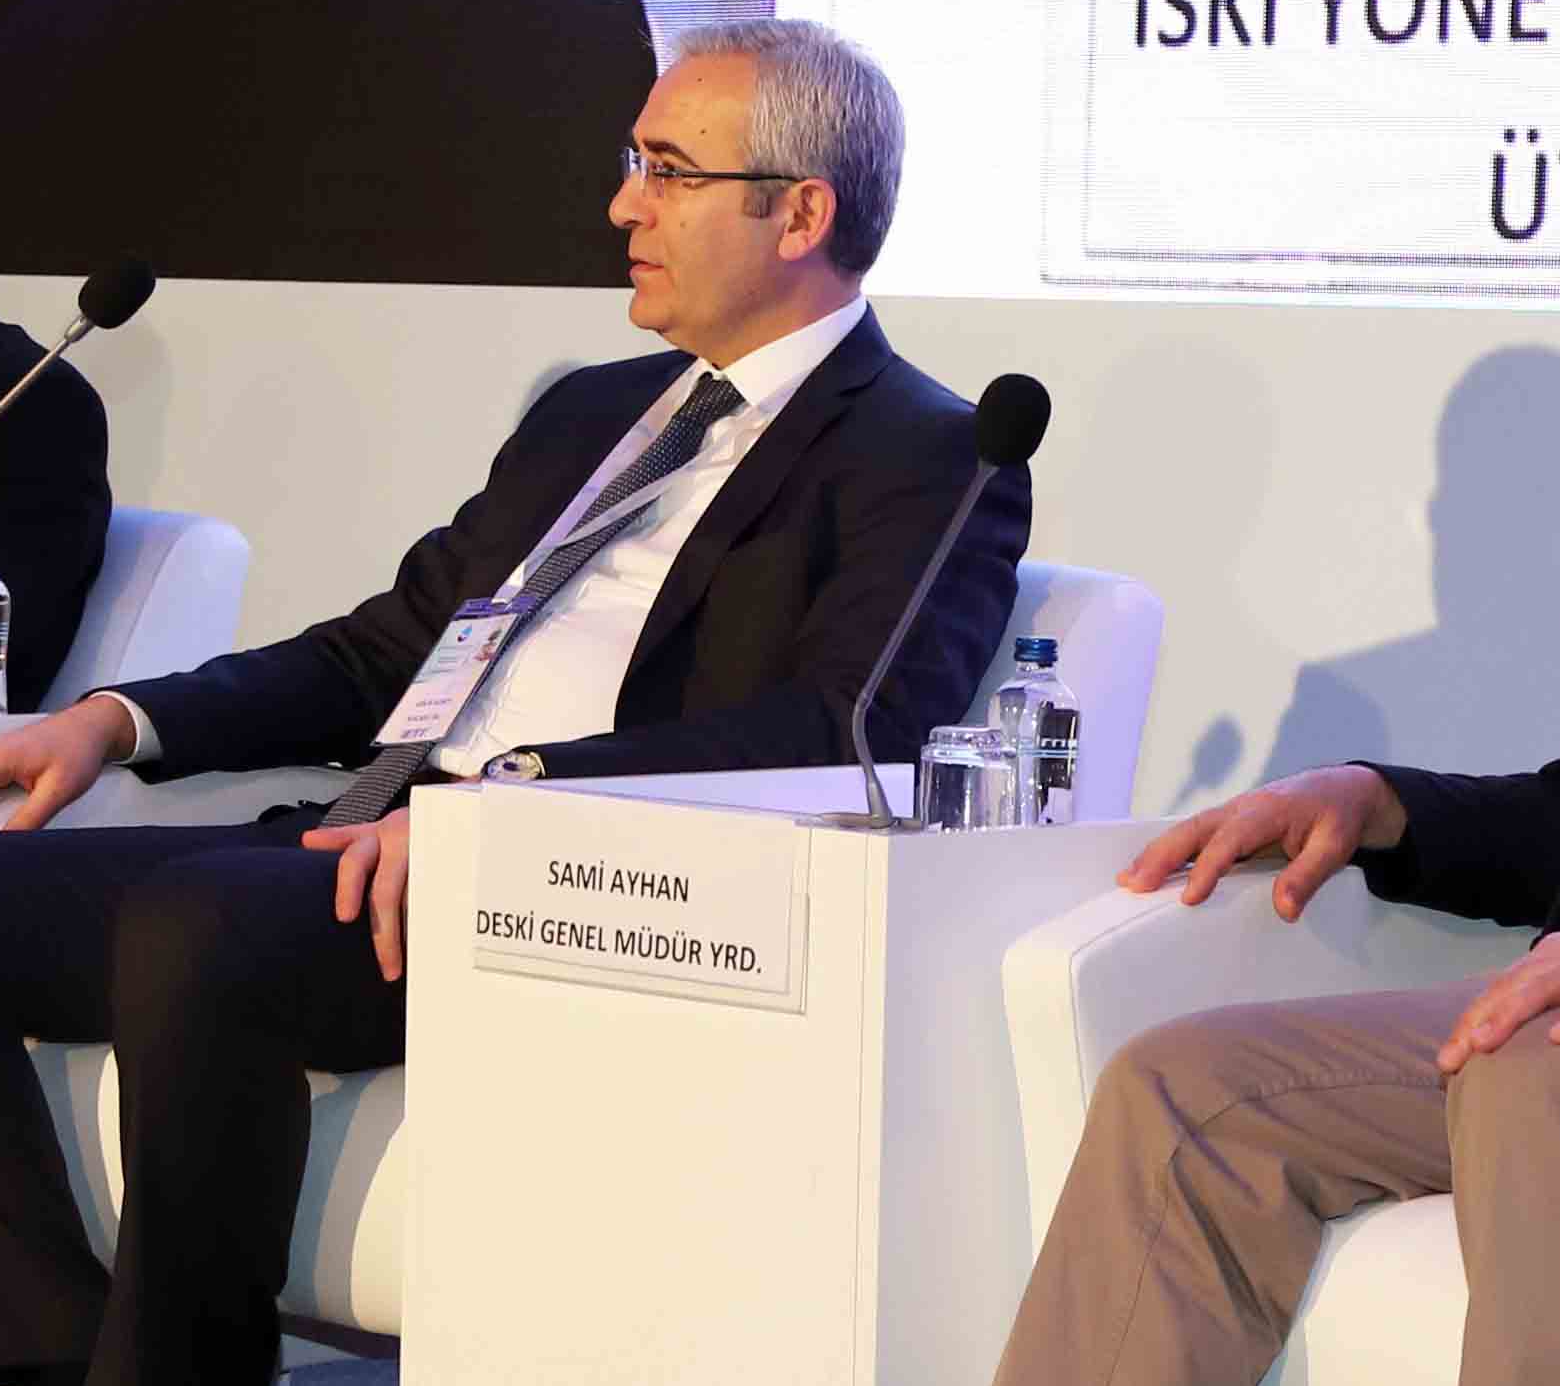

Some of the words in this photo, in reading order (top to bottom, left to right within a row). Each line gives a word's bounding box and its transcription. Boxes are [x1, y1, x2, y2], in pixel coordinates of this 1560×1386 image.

[547, 859, 605, 892] SAMİ
[609, 868, 690, 903] AYHAN
[476, 909, 535, 942] DESKİ
[539, 918, 607, 952] GENEL
[614, 925, 702, 967] MÜDÜR
[709, 941, 762, 974] YRD.
